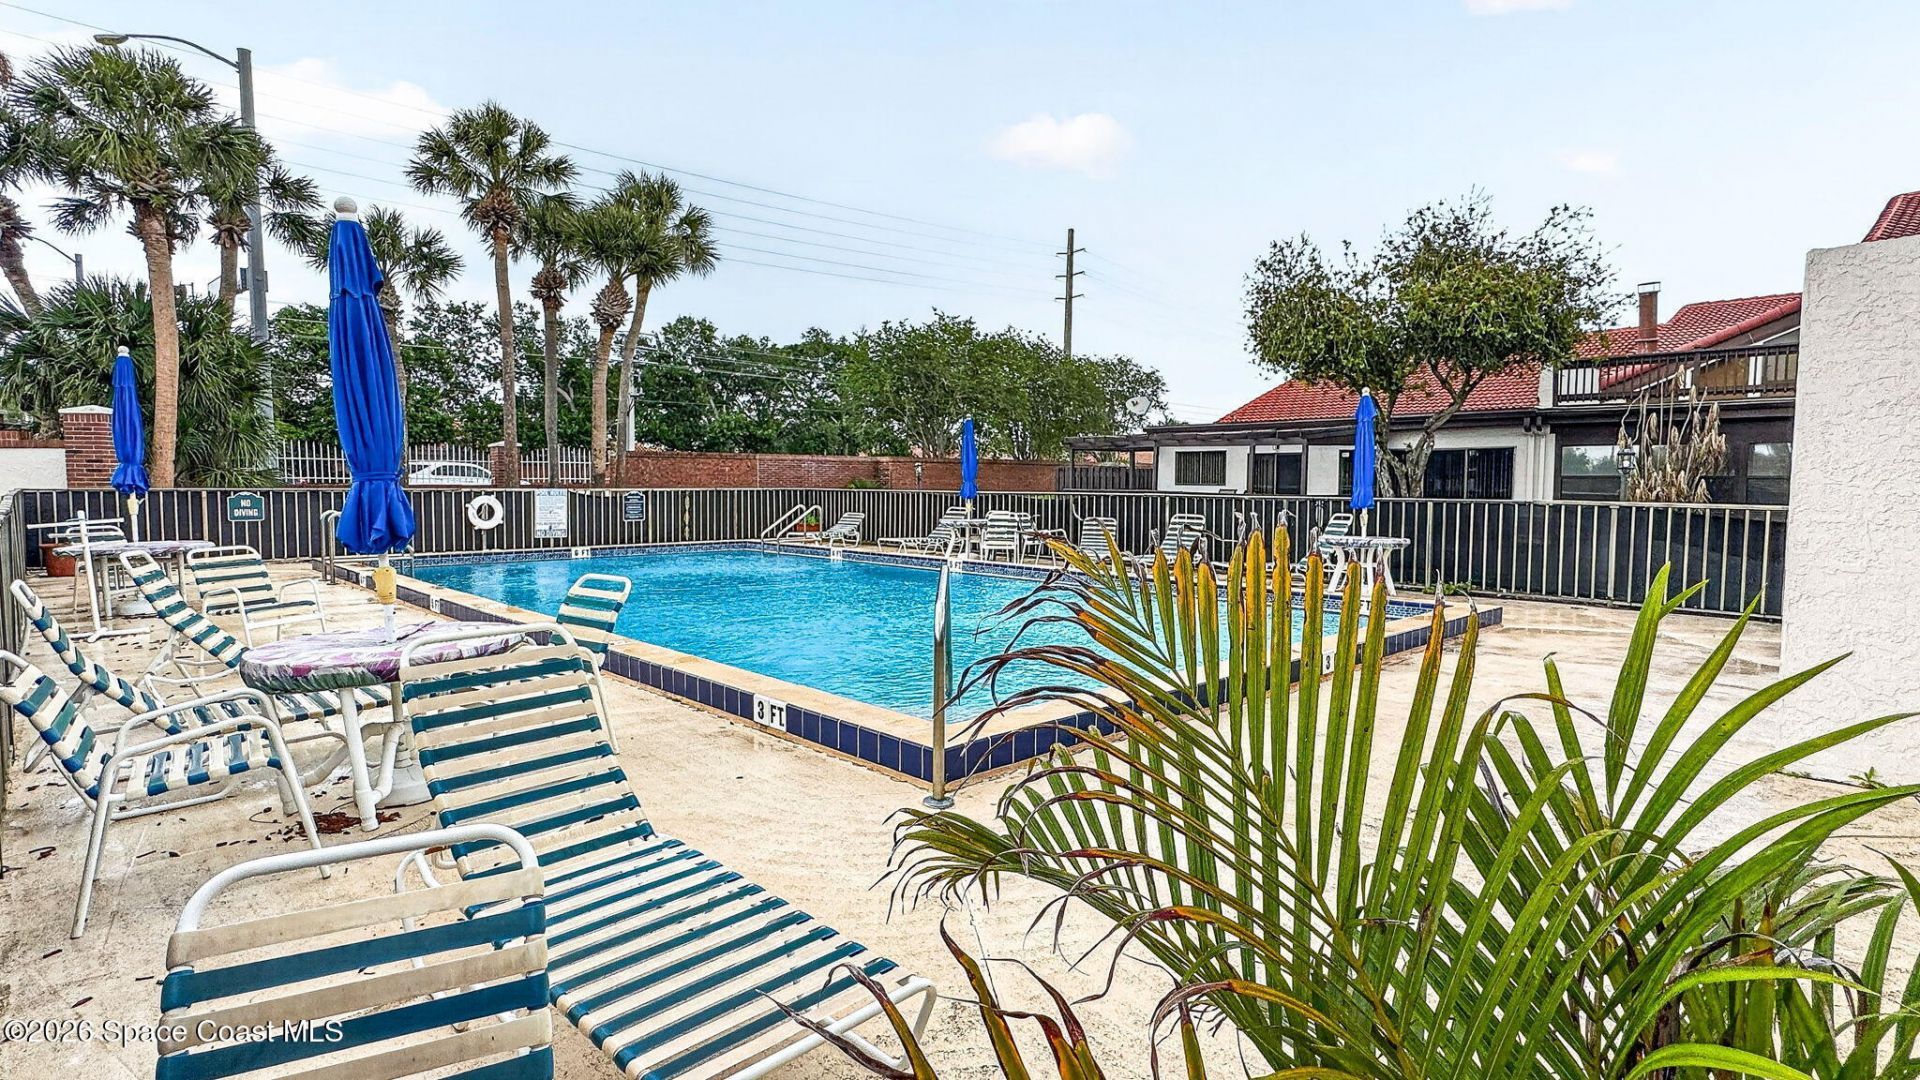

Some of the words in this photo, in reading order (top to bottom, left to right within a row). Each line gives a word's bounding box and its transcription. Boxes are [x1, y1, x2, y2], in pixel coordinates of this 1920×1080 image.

[240, 499, 251, 507] NO
[233, 508, 259, 517] DIVING
[1325, 655, 1331, 670] 3
[757, 700, 765, 720] 3
